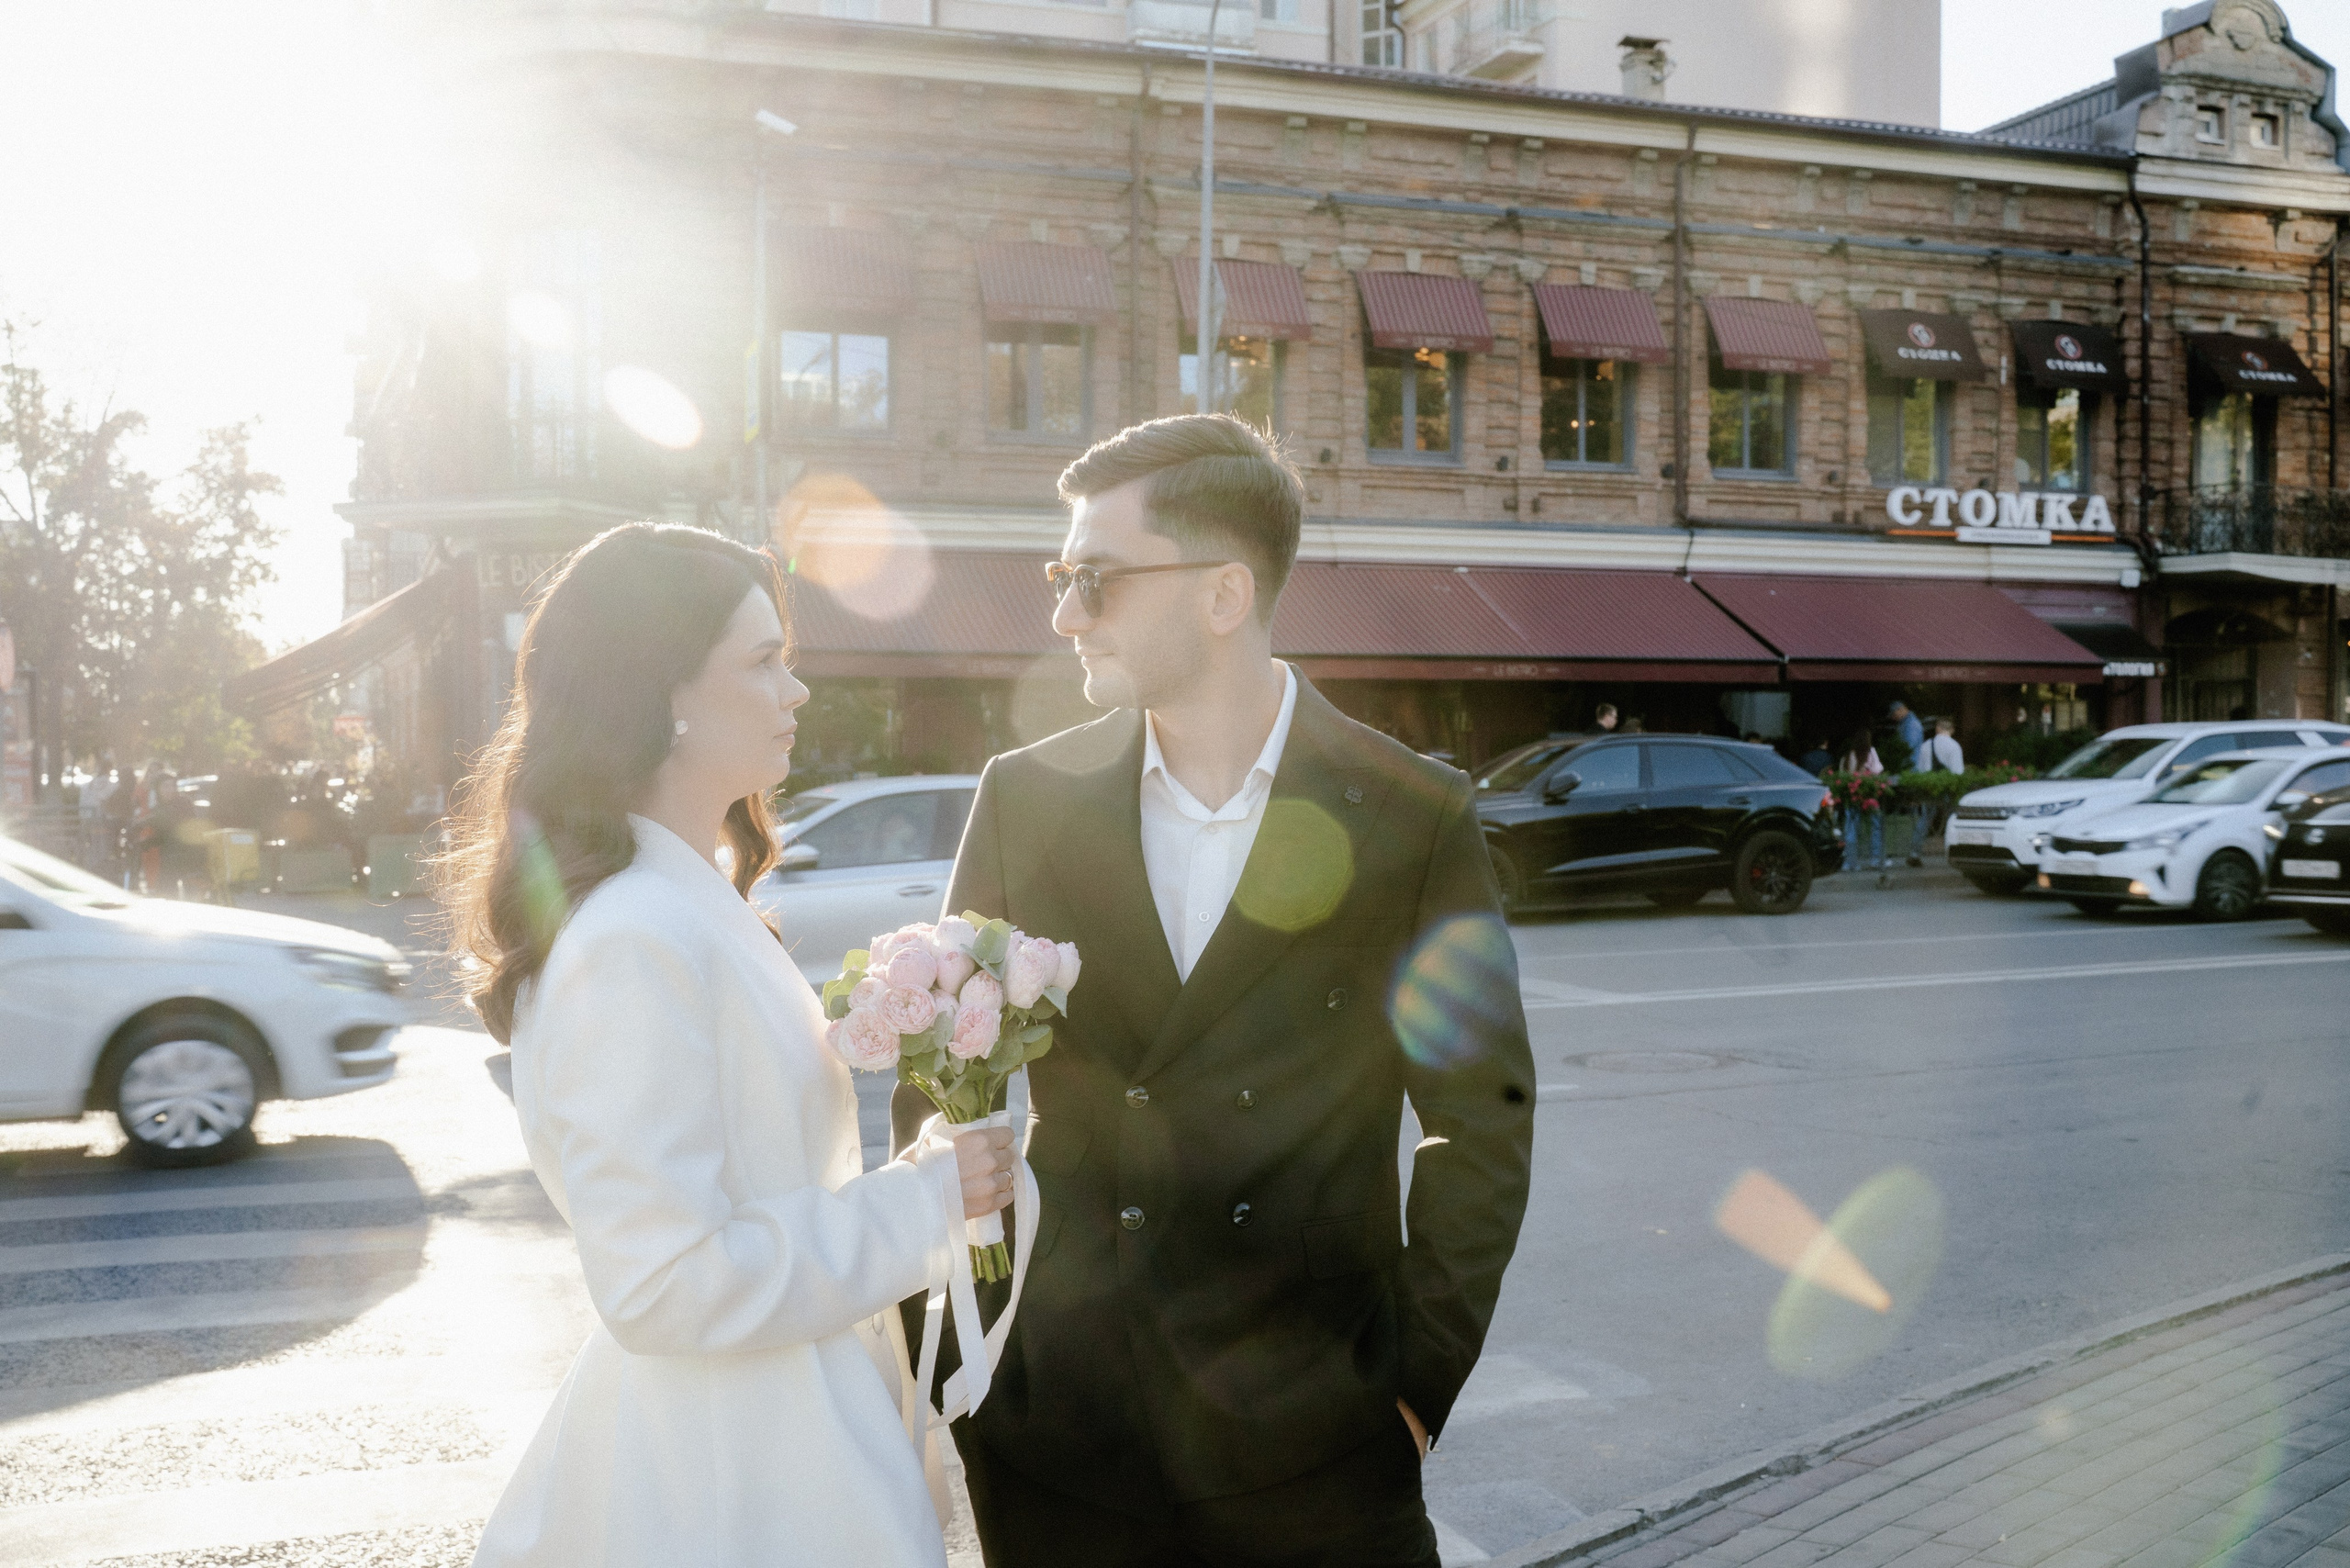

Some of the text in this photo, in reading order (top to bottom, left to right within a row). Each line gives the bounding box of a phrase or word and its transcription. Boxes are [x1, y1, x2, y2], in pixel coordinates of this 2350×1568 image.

[2045, 358, 2108, 374] СТОМКА
[1886, 486, 2116, 532] СТОМКА
[511, 553, 565, 588] BIST
